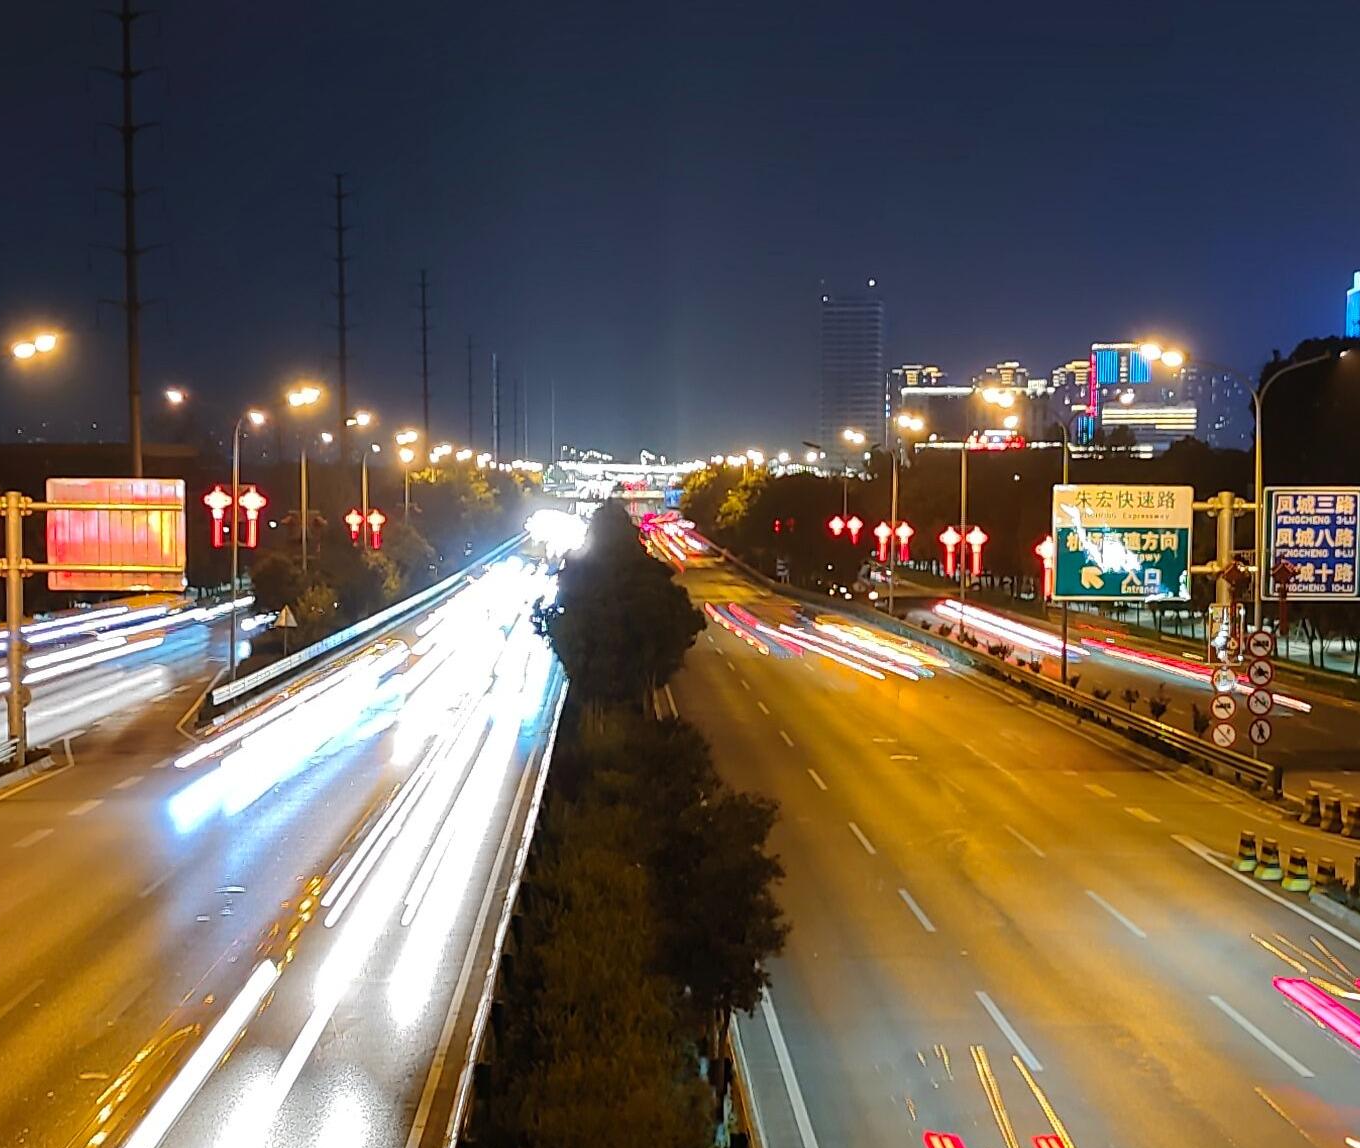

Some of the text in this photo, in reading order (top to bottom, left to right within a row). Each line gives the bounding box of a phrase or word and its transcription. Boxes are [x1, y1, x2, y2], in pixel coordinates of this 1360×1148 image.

[1075, 491, 1176, 509] 朱宏快速路
[1276, 495, 1356, 515] 凤城三路
[1277, 515, 1331, 525] FENGCHENG
[1275, 527, 1355, 548] 凤城八路
[1122, 568, 1162, 586] 入口
[1276, 562, 1354, 583] 城十路
[1275, 583, 1326, 592] FNGCHENG
